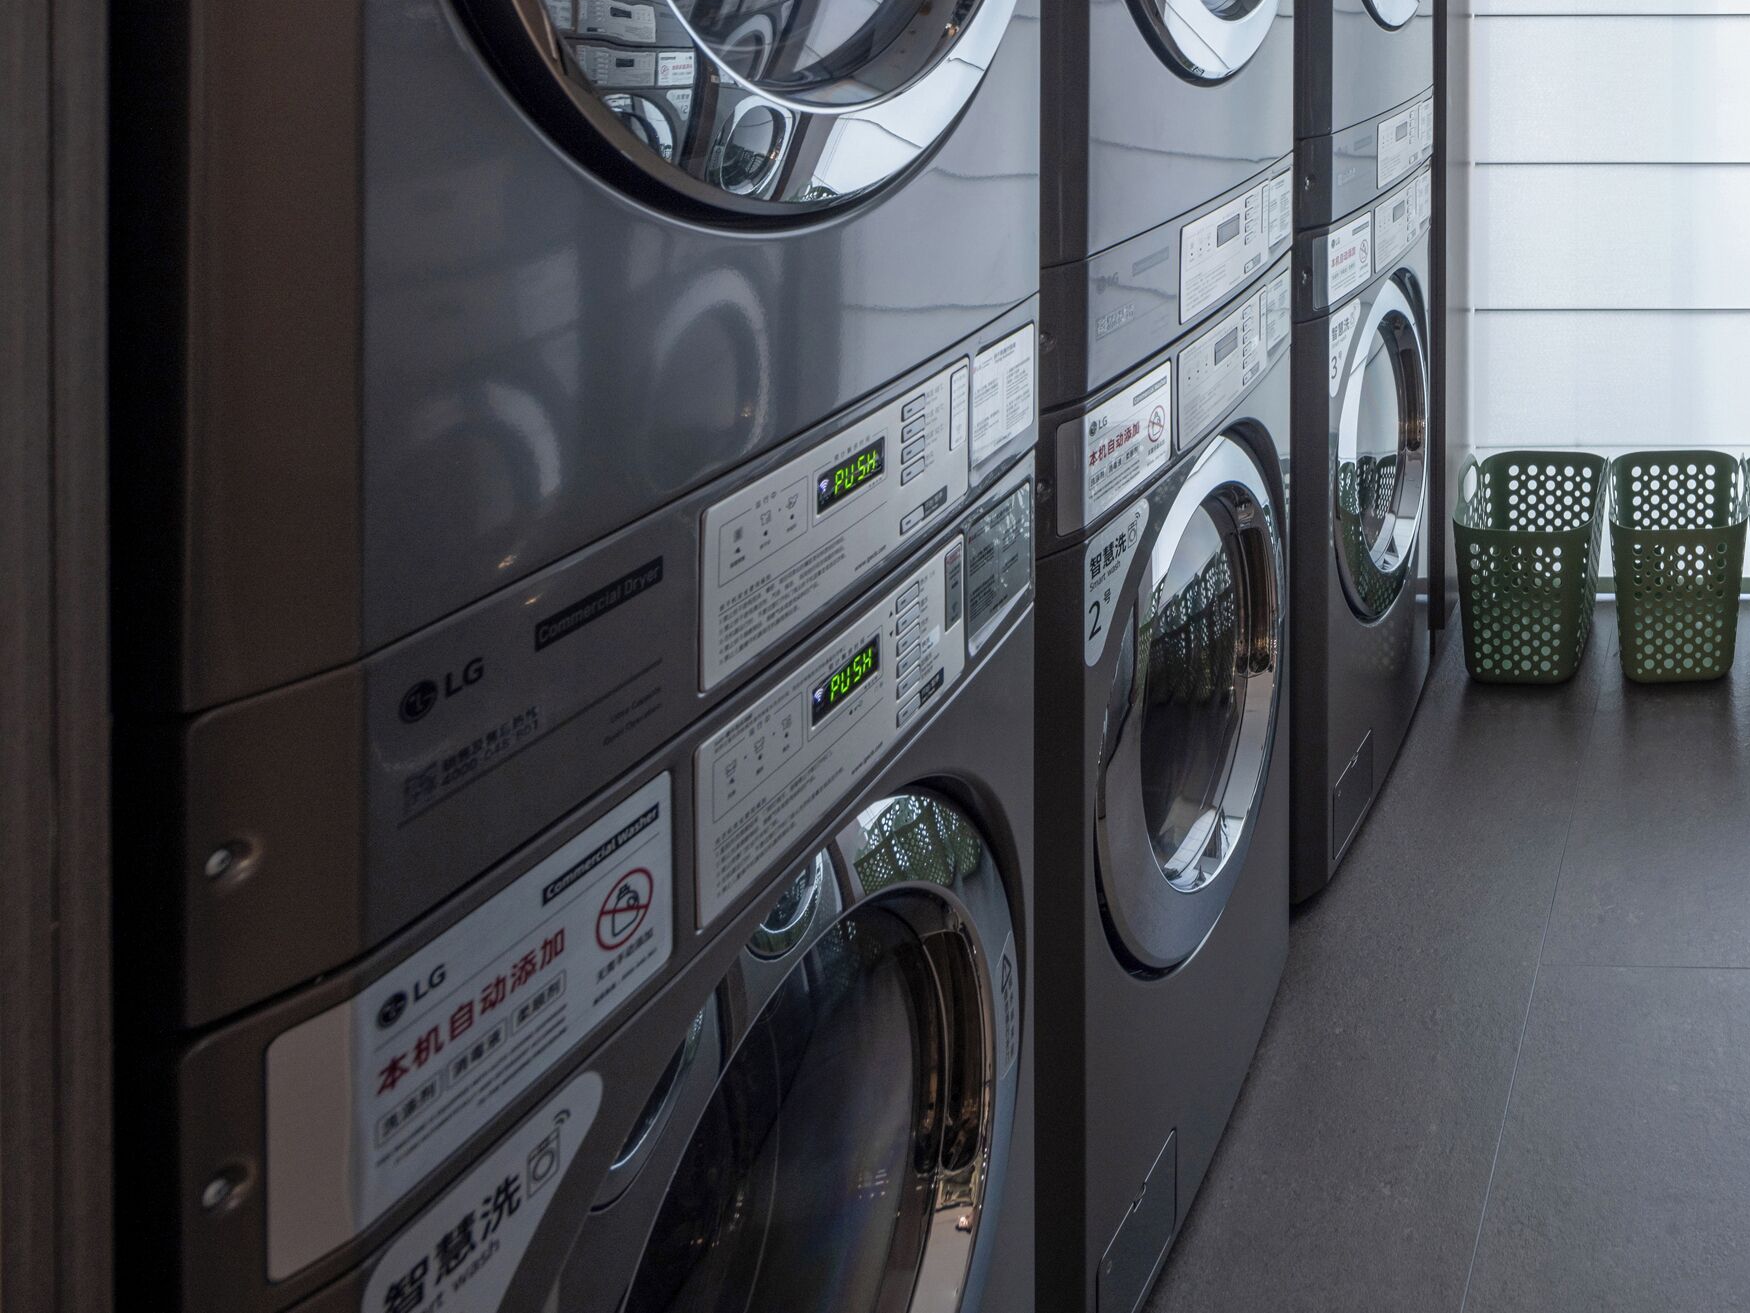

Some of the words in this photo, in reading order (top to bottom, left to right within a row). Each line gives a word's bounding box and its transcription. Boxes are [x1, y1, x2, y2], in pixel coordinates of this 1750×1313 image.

[1331, 356, 1338, 381] 3
[1089, 422, 1140, 468] 本机自动添加
[1098, 415, 1108, 432] LG
[833, 449, 878, 496] PUSH
[1089, 532, 1127, 580] 智慧洗
[1089, 570, 1107, 592] Smart
[1107, 559, 1122, 577] wash
[539, 587, 621, 644] Commercial
[624, 564, 660, 602] Dryer
[1088, 601, 1102, 642] 2
[1103, 588, 1111, 605] 号
[444, 656, 485, 700] LG
[829, 647, 873, 703] PUSH
[546, 837, 615, 898] Commercial
[617, 805, 658, 850] Washer
[413, 962, 447, 1004] LG
[377, 927, 565, 1095] 本机自动添加
[451, 1026, 501, 1082] 消毒液
[383, 1174, 521, 1313] 智慧洗
[451, 1240, 501, 1292] wash
